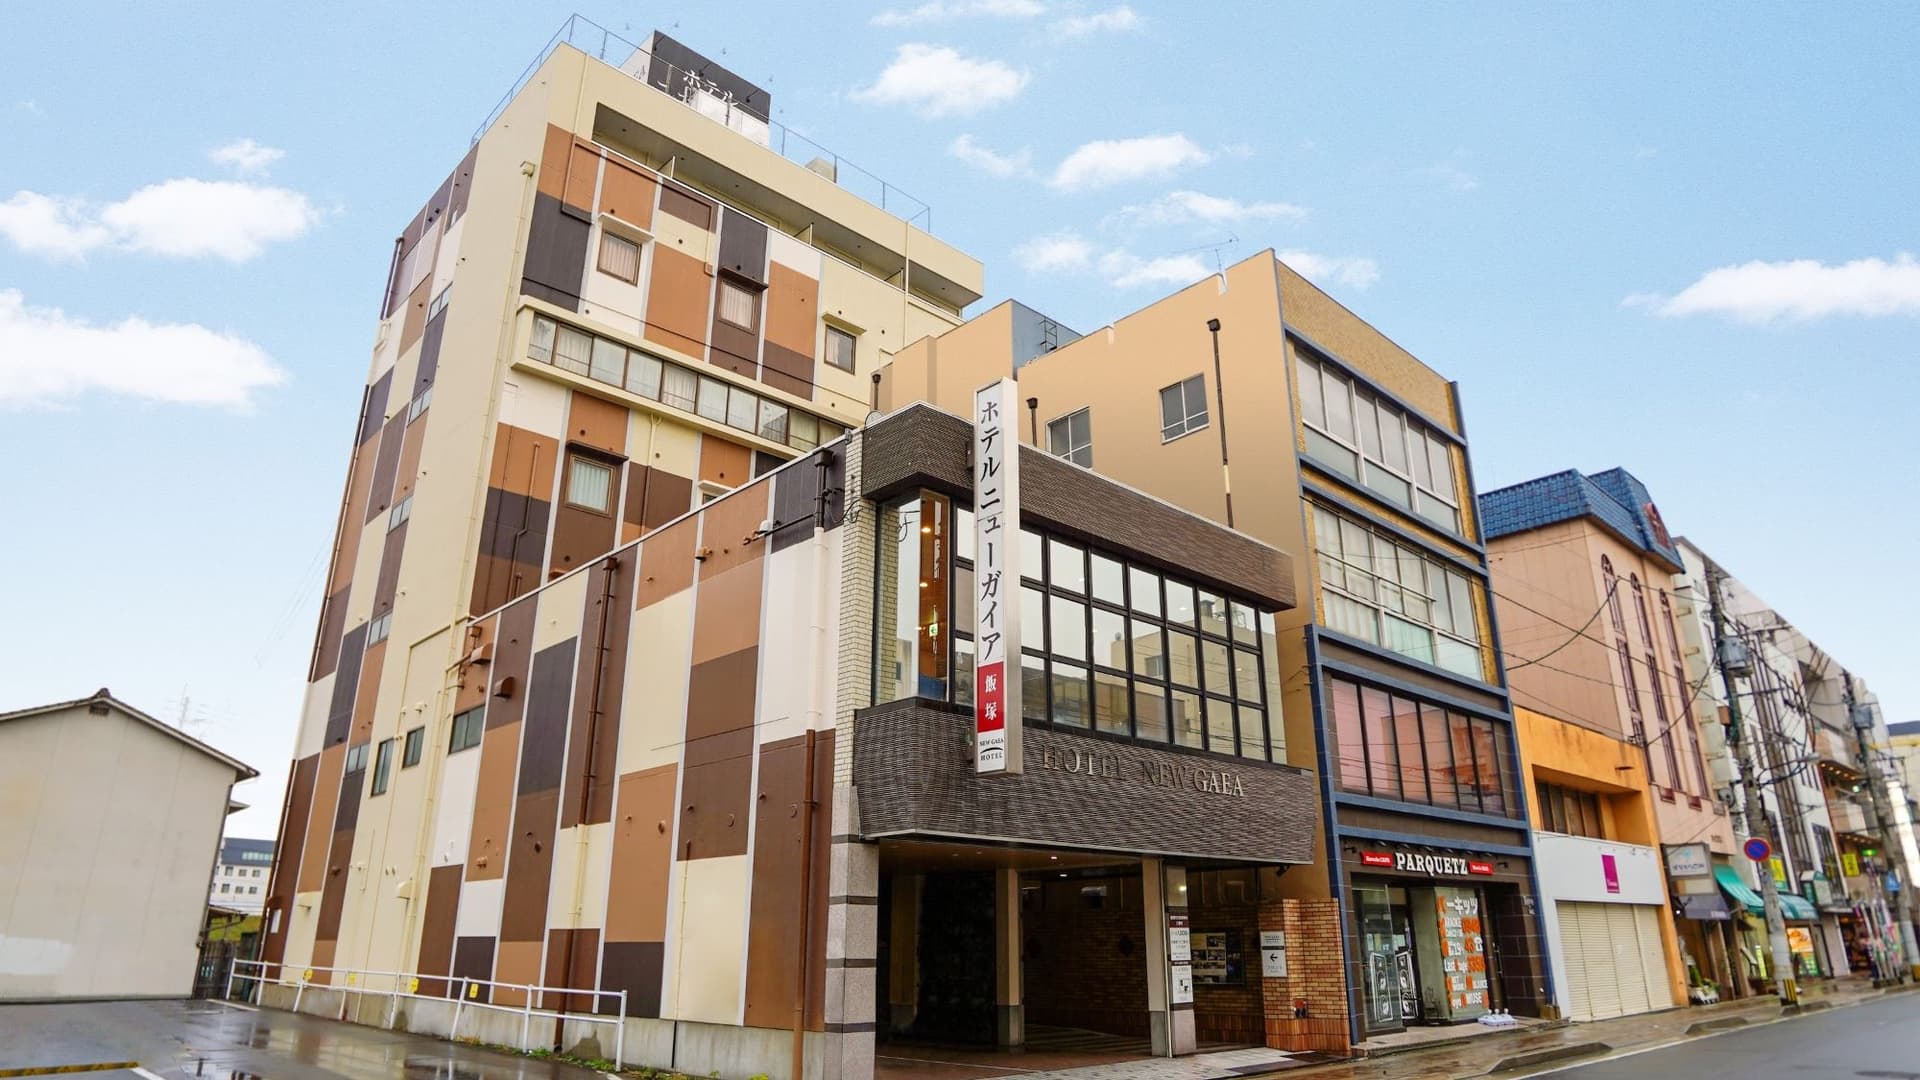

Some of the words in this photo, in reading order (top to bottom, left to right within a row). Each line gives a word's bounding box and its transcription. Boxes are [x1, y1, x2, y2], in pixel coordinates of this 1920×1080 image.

[980, 401, 1002, 660] ホテルニューガイア
[985, 673, 998, 721] 飯塚
[980, 752, 1003, 761] HOTEL
[1041, 744, 1127, 781] HOTEL
[1141, 759, 1187, 790] NEW
[1192, 767, 1245, 798] GAEA
[1394, 852, 1469, 877] PARQUETZ
